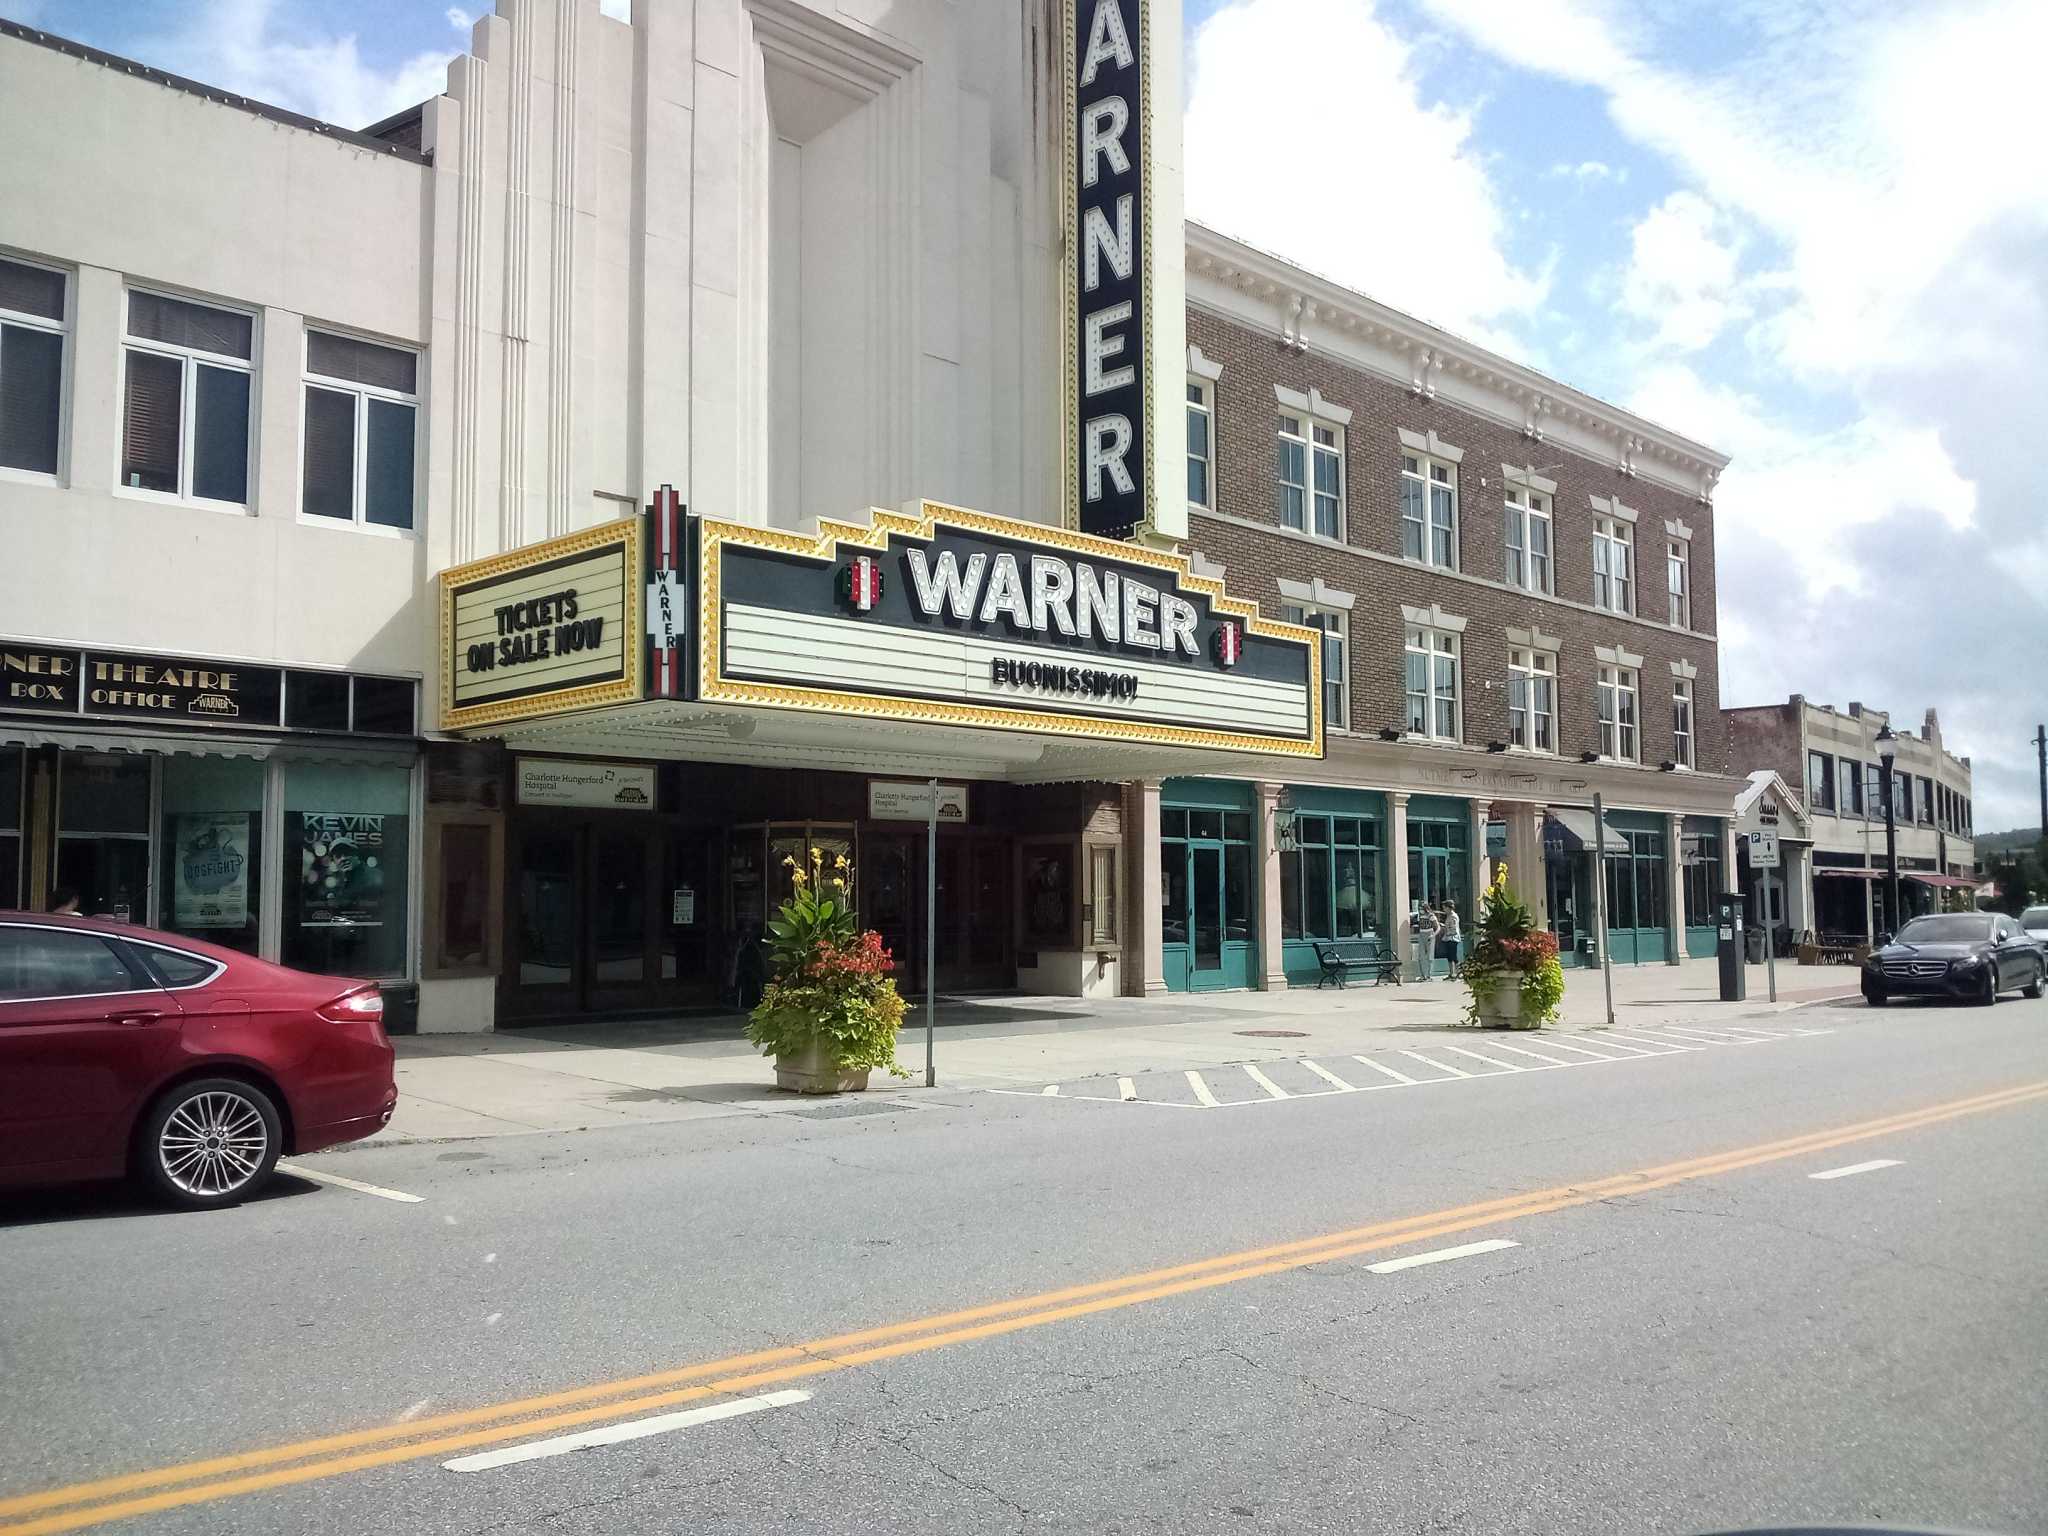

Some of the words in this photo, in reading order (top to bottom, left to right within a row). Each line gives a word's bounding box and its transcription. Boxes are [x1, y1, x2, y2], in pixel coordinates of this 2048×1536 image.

[494, 589, 577, 636] TICKETS
[656, 571, 676, 648] WARNER
[907, 547, 1200, 656] WARNER
[467, 641, 495, 673] ON
[499, 629, 550, 667] SALE
[554, 617, 604, 657] NOW
[0, 653, 74, 676] NER
[91, 661, 239, 691] THEATRE
[992, 657, 1138, 700] BUONISSIMO!
[11, 682, 64, 700] BOX
[90, 689, 176, 709] OFFICE
[525, 772, 561, 782] Charlotte
[562, 775, 604, 785] Hungerford
[525, 782, 557, 791] Hospital
[303, 814, 383, 832] KEVIN
[304, 831, 384, 845] JAMES
